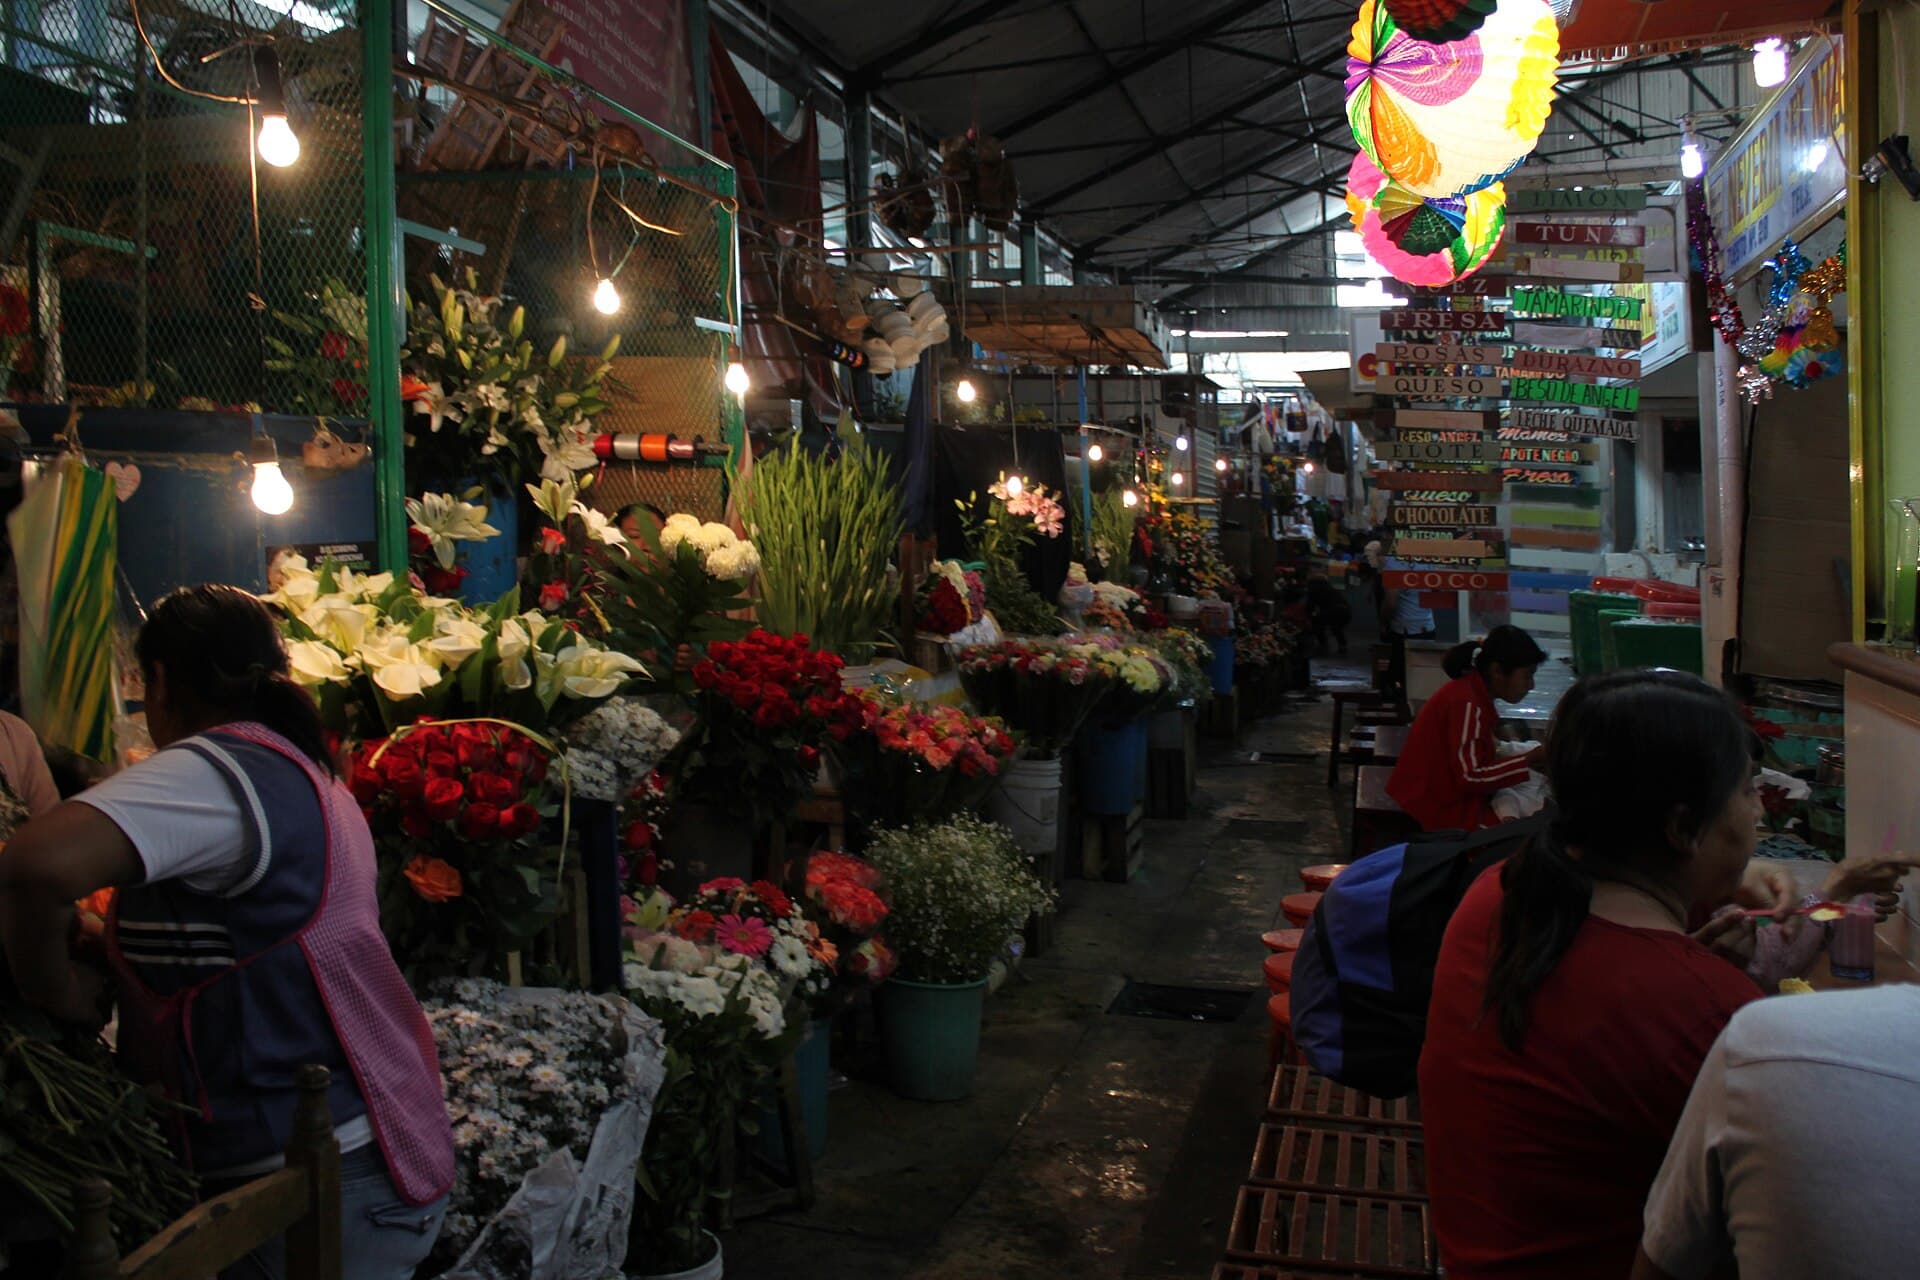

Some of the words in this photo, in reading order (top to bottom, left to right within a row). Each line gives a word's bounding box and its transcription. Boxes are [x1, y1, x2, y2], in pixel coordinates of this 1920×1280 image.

[1536, 226, 1630, 243] TUNA
[1520, 290, 1632, 319] TAMARINDO
[1393, 311, 1499, 328] FRESA
[1394, 345, 1485, 362] ROSAS
[1522, 353, 1633, 377] DURAZNO
[1395, 378, 1484, 393] QUESO
[1584, 385, 1632, 410] ANGEL
[1518, 411, 1556, 430] LECHE
[1563, 414, 1634, 439] QUEMADA
[1392, 445, 1484, 458] ELOTE
[1500, 447, 1540, 462] APOTE
[1394, 505, 1490, 525] CHOCOLATE
[1402, 572, 1489, 588] COCO
